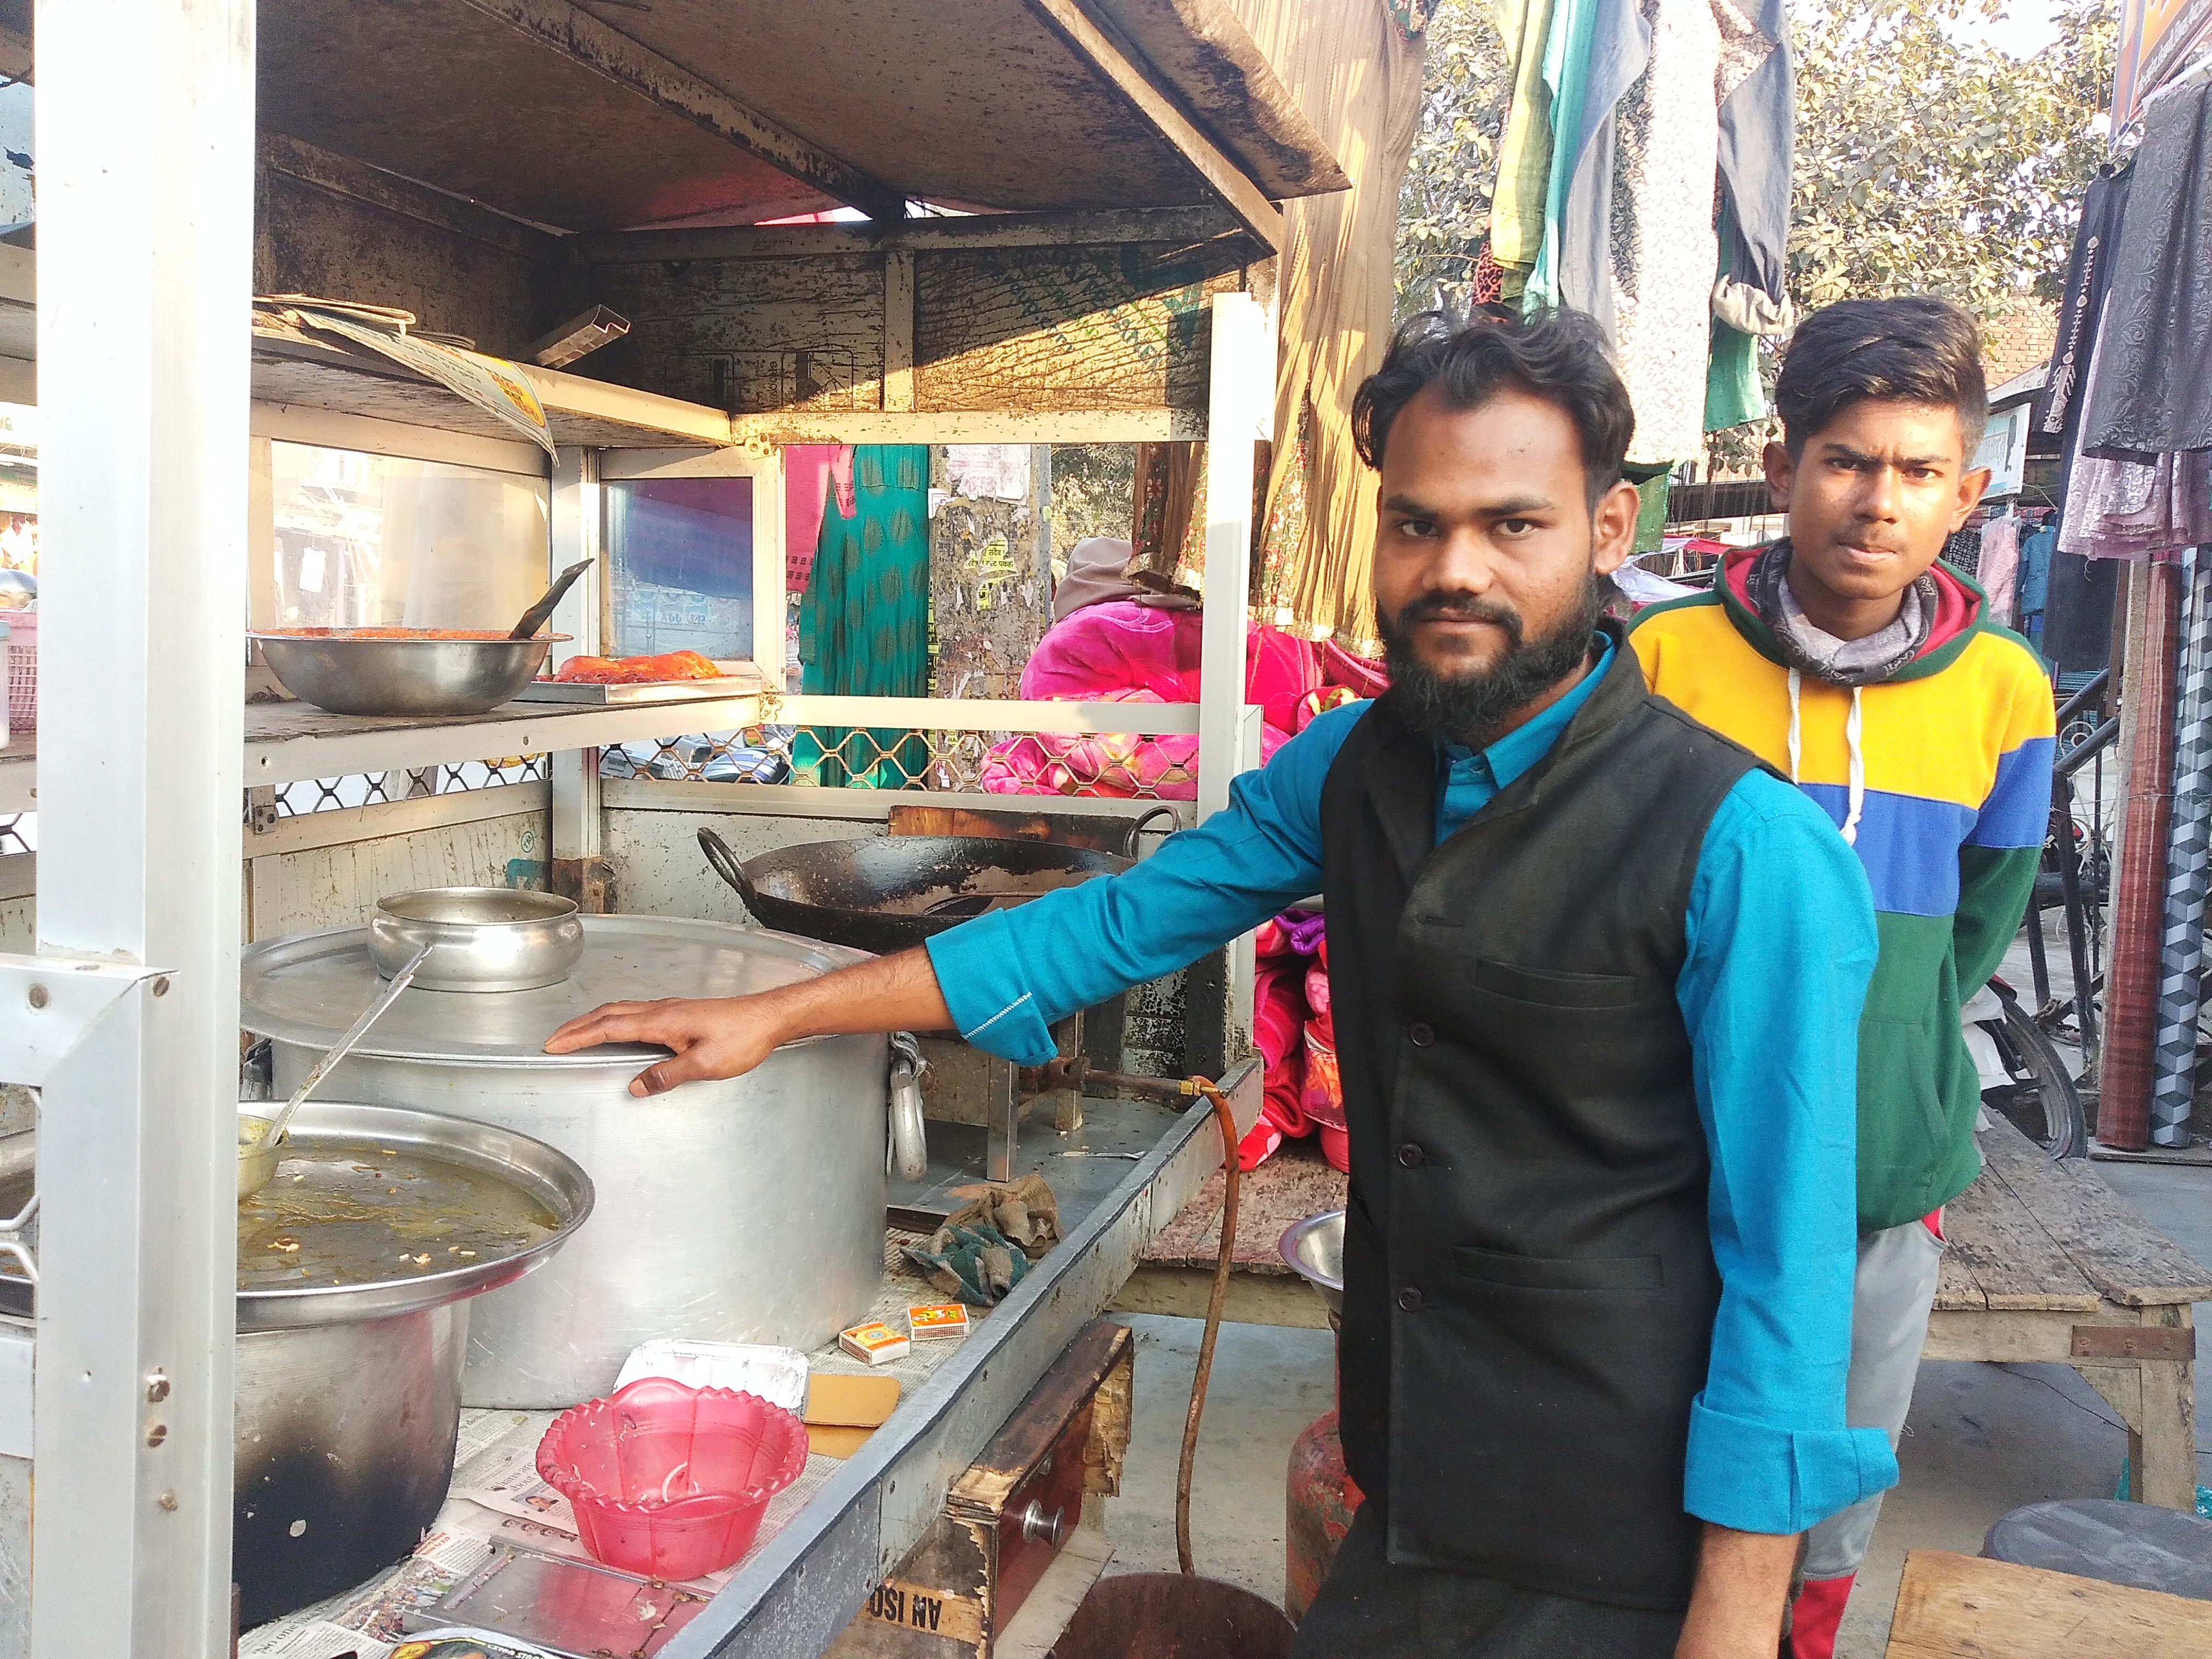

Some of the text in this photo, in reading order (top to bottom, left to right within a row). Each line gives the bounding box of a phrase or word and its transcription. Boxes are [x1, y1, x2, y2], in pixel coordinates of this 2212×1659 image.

[988, 547, 1001, 556] सदैव
[510, 1476, 535, 1492] about
[868, 1586, 942, 1630] AN ISO
